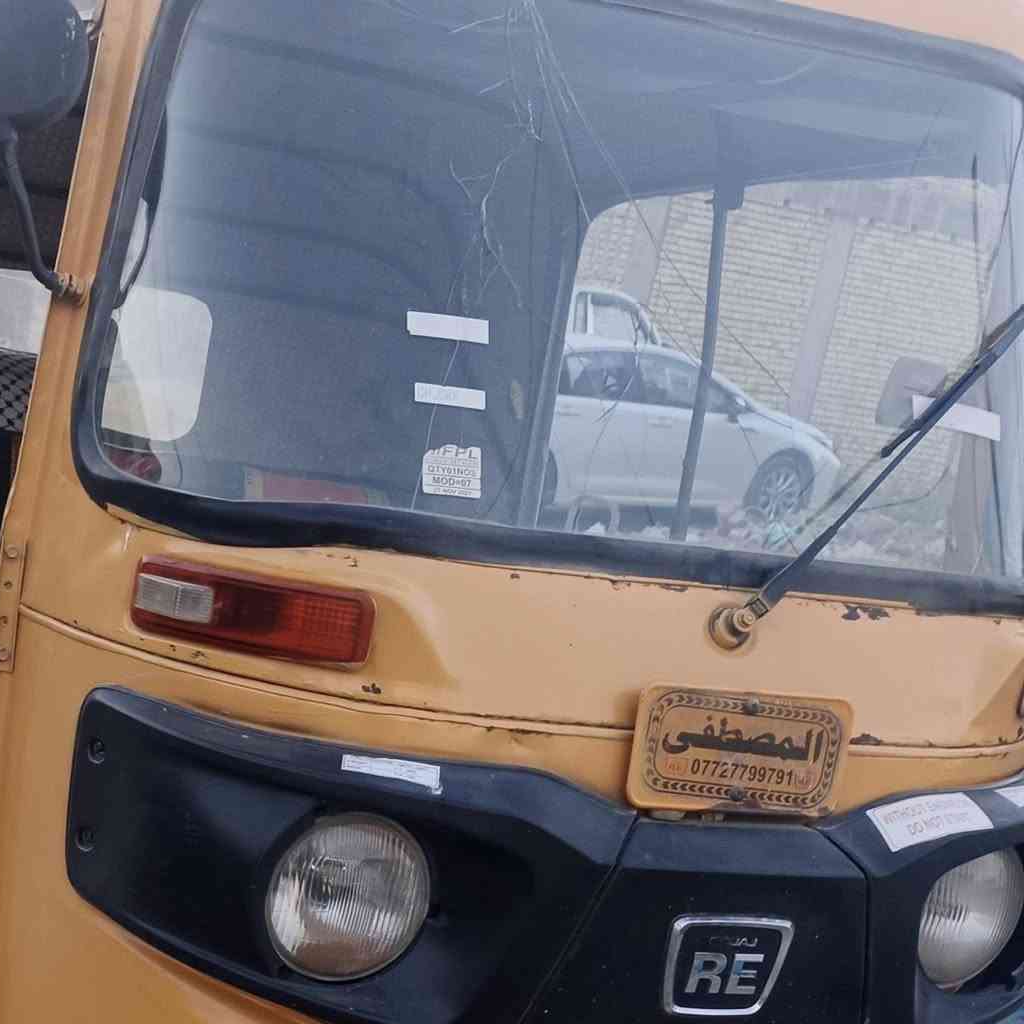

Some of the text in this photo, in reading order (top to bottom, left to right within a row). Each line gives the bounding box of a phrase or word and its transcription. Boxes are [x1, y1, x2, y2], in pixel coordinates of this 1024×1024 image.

[662, 715, 825, 764] المصطفى
[690, 758, 793, 786] 07727799791
[684, 951, 764, 994] RE
